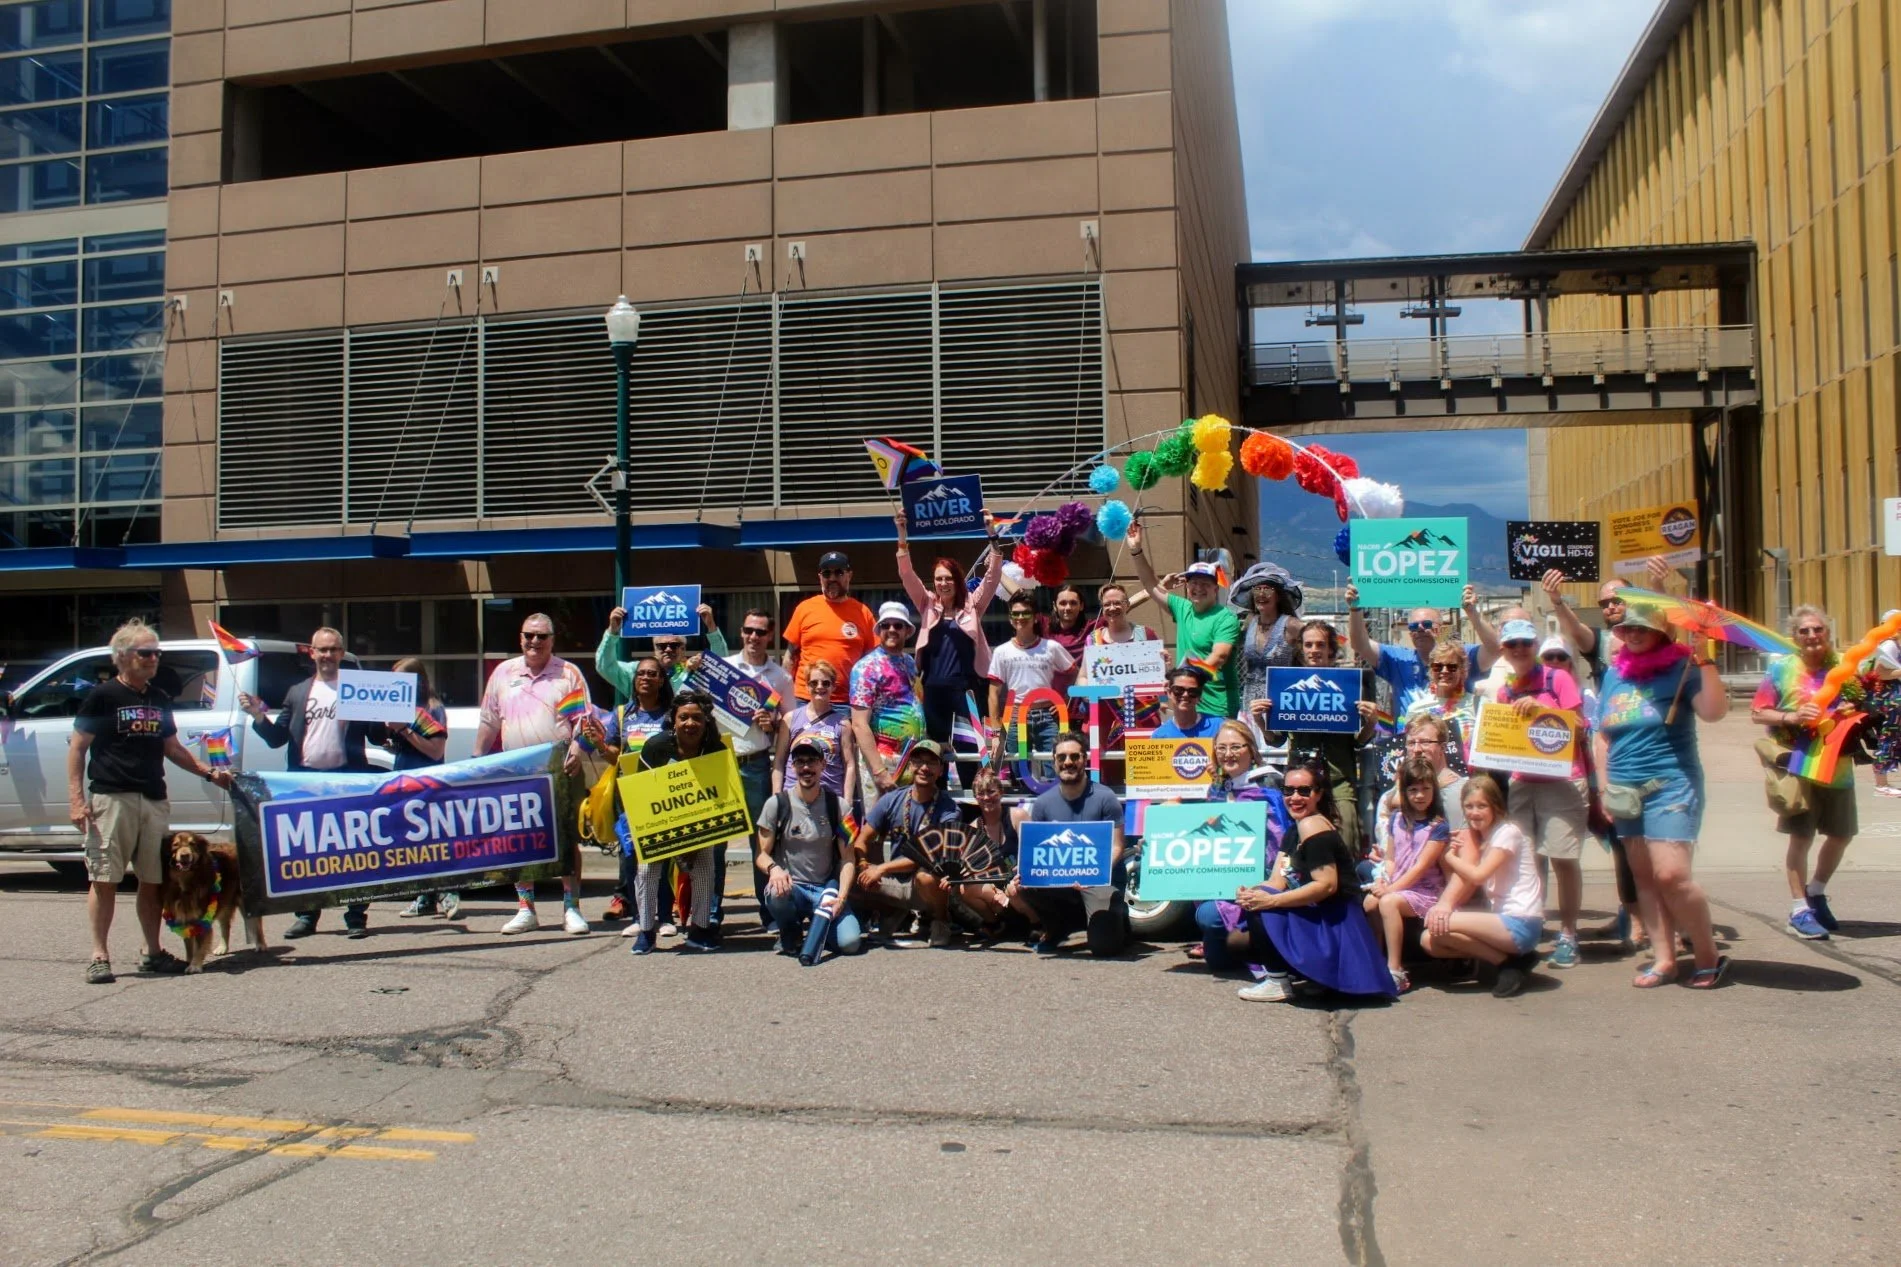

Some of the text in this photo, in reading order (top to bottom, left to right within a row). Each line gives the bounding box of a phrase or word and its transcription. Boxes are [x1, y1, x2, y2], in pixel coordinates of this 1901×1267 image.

[914, 497, 973, 519] RIVER
[915, 515, 976, 528] FOR COLORADO
[1612, 516, 1630, 524] VOTE
[1613, 520, 1650, 530] CONGRESS
[1661, 521, 1695, 533] REAGAN
[1522, 544, 1594, 557] VIGIL HD-16
[1357, 542, 1459, 576] LÓPEZ
[633, 604, 688, 621] RIVER
[632, 620, 690, 629] FOR COLORADO
[1100, 663, 1161, 676] VIGIL HD-16
[341, 683, 412, 703] Dowell
[729, 685, 761, 710] REAGAN
[1280, 691, 1347, 712] RIVER
[1278, 713, 1348, 722] FOR COLORADO
[131, 720, 160, 732] OUT
[1529, 729, 1570, 739] REAGAN
[668, 768, 688, 780] Elect
[669, 781, 694, 793] Detra
[650, 786, 719, 815] DUNCAN
[276, 791, 544, 857] MARC SNYDER
[635, 824, 645, 832] for
[645, 817, 668, 829] County
[669, 806, 713, 823] Commissioner
[1148, 830, 1257, 867] LÓPEZ
[281, 832, 547, 880] COLORADO SENATE DISTRICT 12
[1032, 846, 1099, 866] RIVER
[1031, 867, 1100, 877] FOR COLORADO
[1196, 866, 1256, 874] COMMISSIONER
